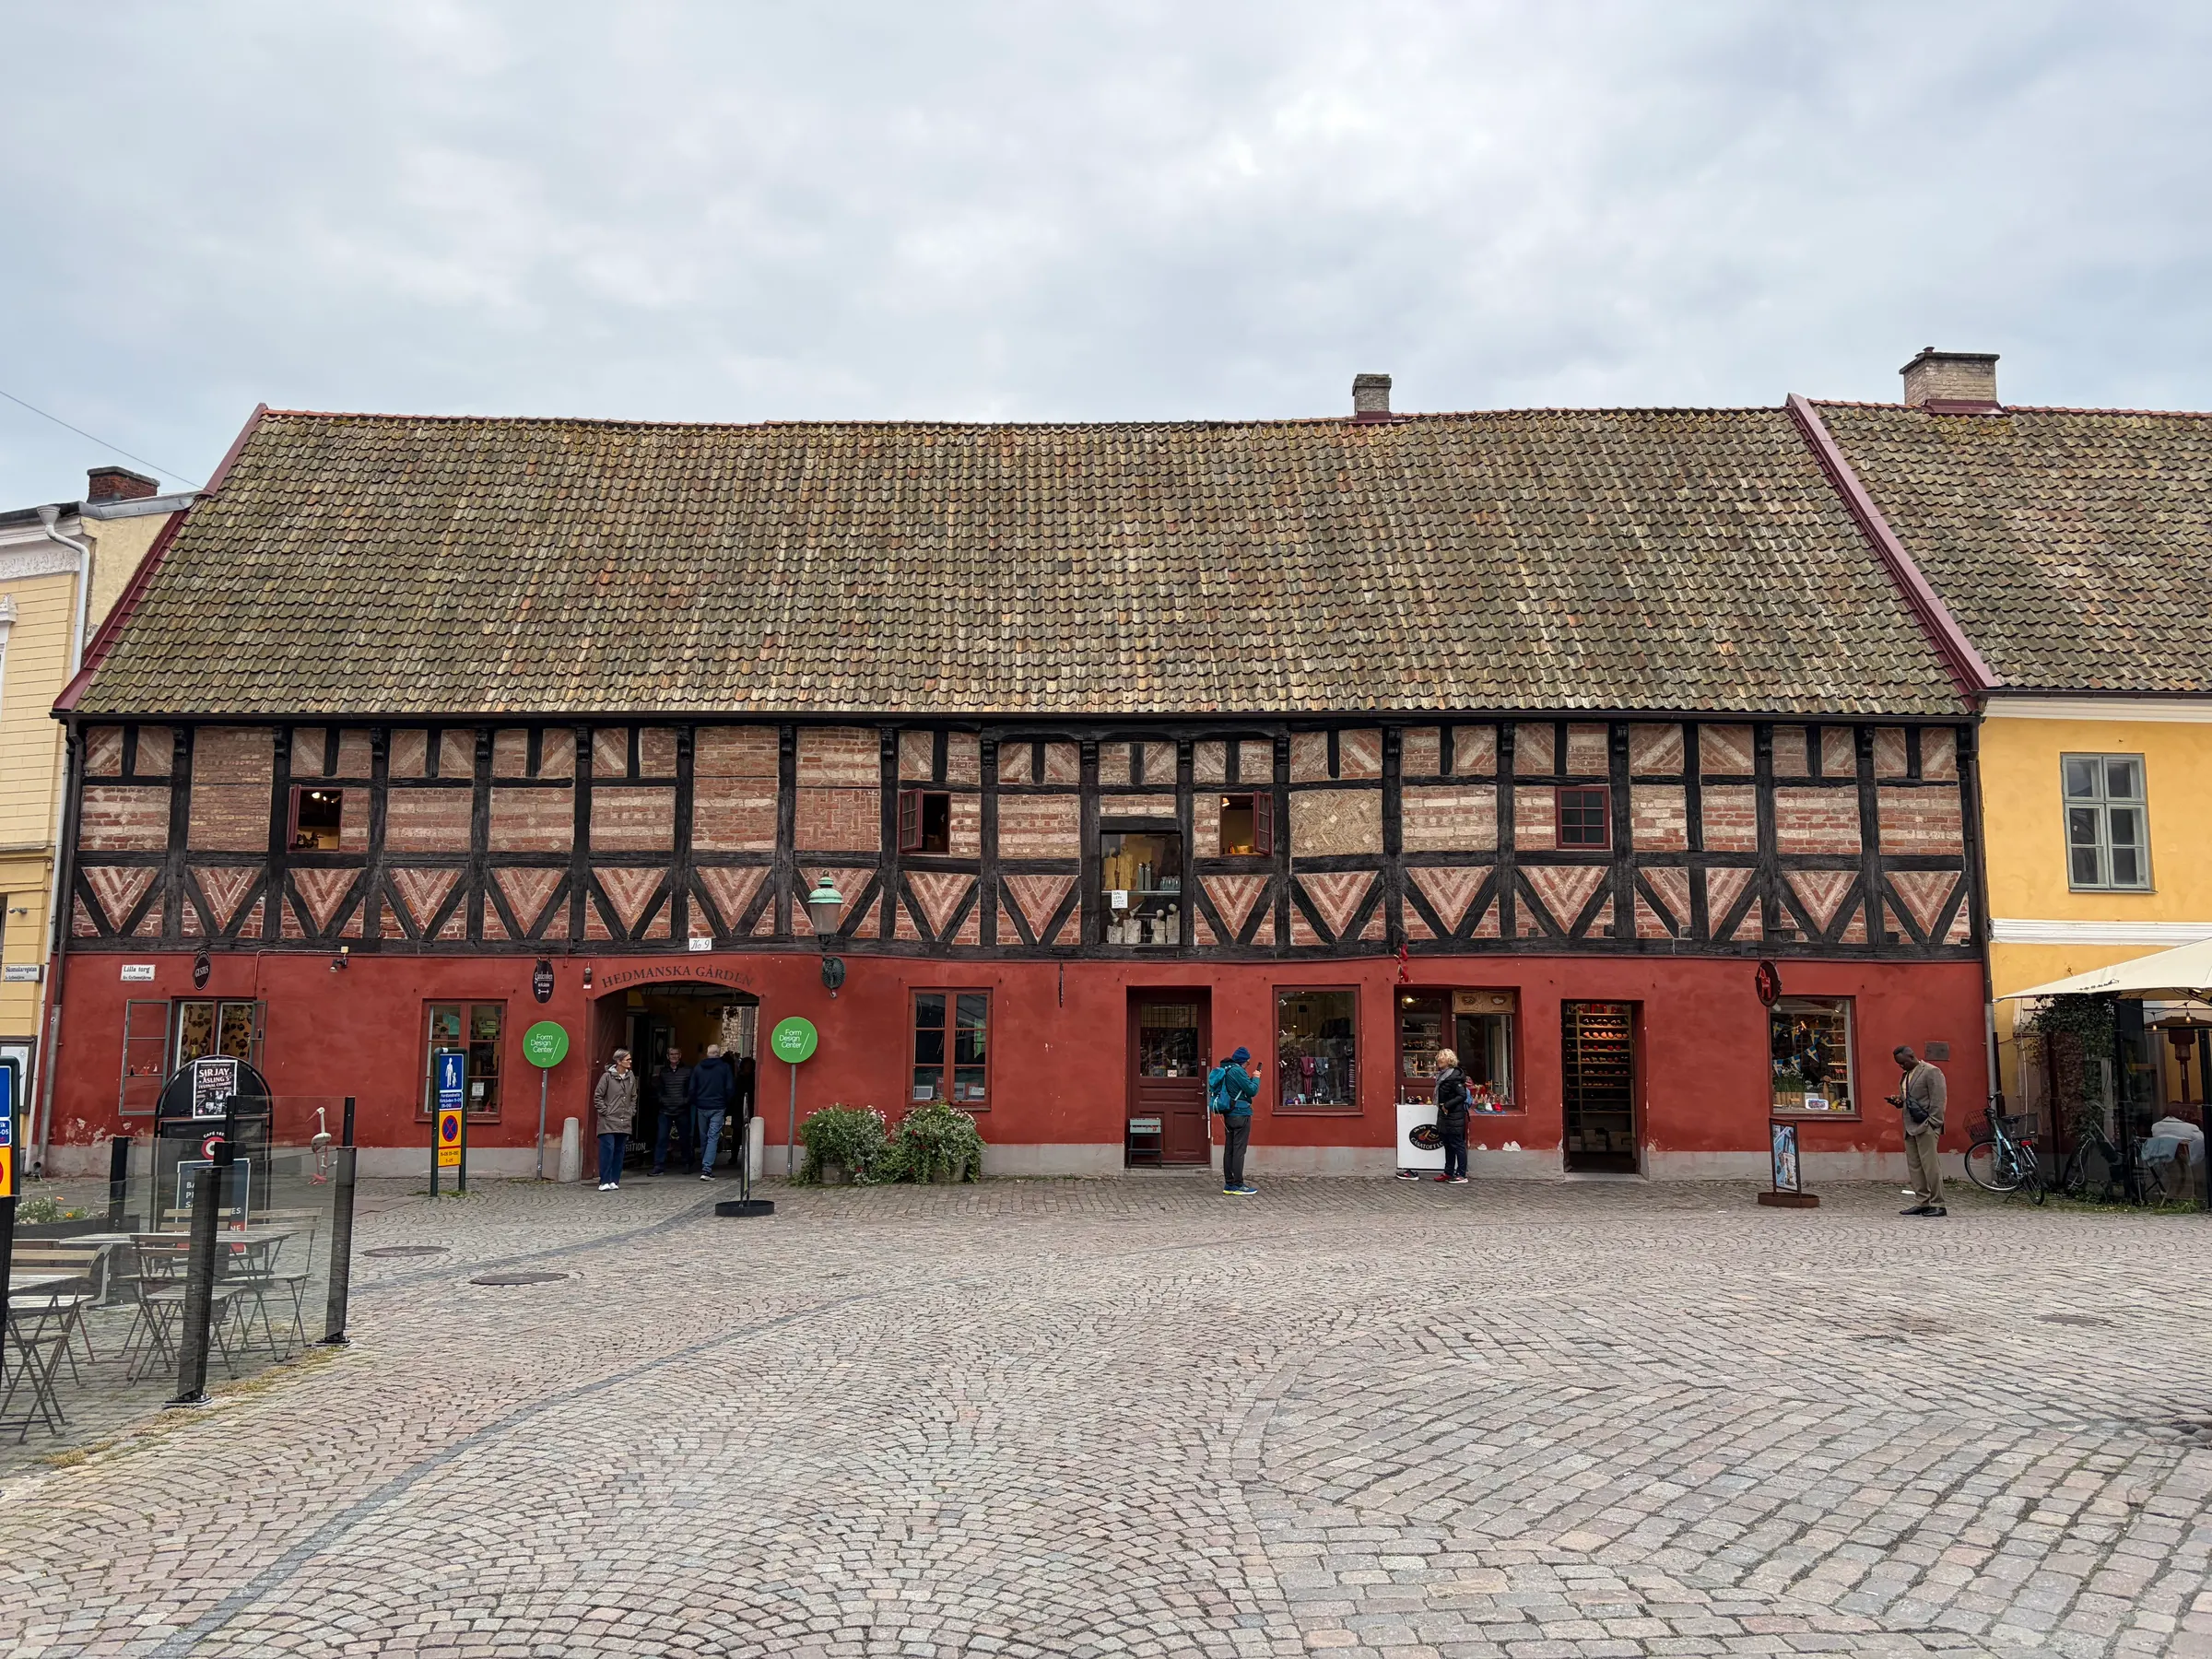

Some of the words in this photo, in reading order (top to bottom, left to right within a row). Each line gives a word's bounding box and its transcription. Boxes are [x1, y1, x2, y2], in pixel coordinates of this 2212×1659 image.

[704, 939, 711, 949] 9
[601, 966, 690, 988] HEDMANSKA
[695, 965, 754, 987] GÅRDEN
[625, 1142, 646, 1152] BITION
